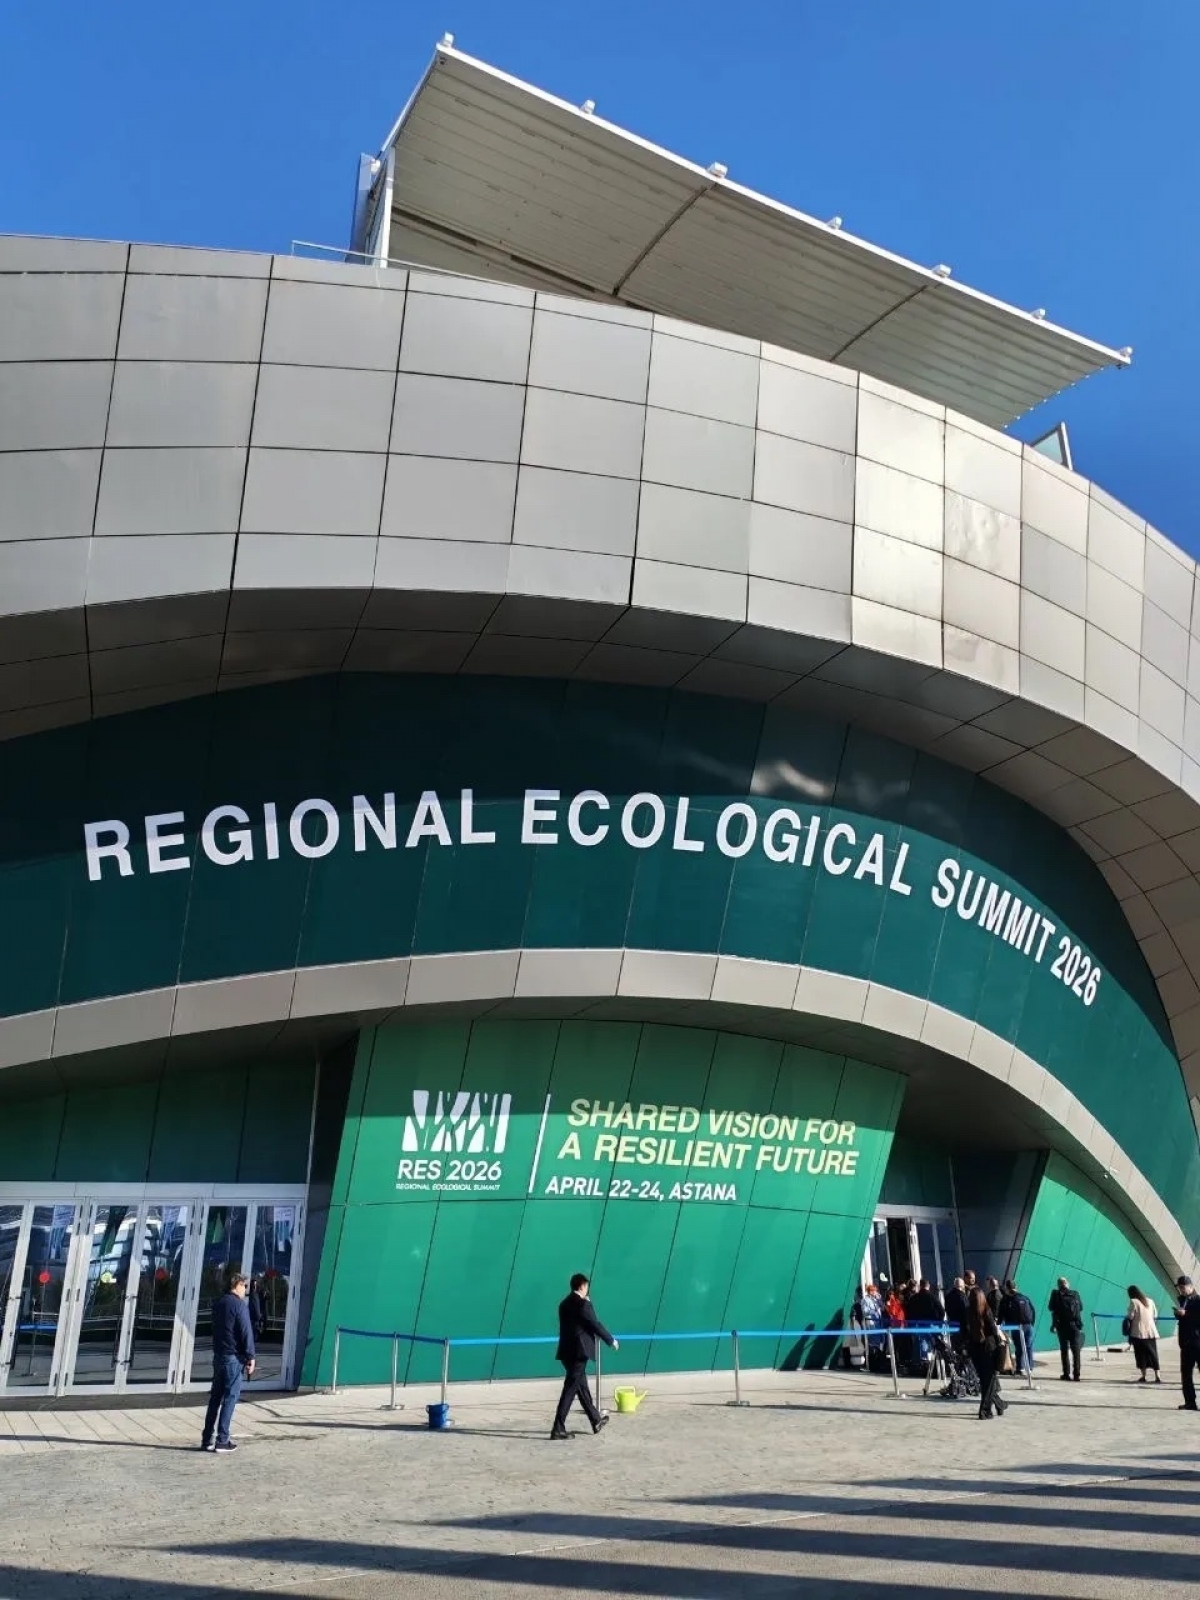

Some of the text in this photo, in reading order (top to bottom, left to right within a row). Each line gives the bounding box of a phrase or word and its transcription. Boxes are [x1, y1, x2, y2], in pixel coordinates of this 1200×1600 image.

[83, 788, 1102, 1007] REGIONAL ECOLOGICAL SUMMIT 2026
[567, 1098, 856, 1145] SHARED VISION FOR
[397, 1159, 502, 1181] RES 2026
[557, 1132, 859, 1176] A RESILIENT FUTURE
[395, 1183, 430, 1191] REGIONAL
[432, 1183, 472, 1191] ECOLOGICAL
[545, 1176, 738, 1202] APRIL 22-24, ASTANA
